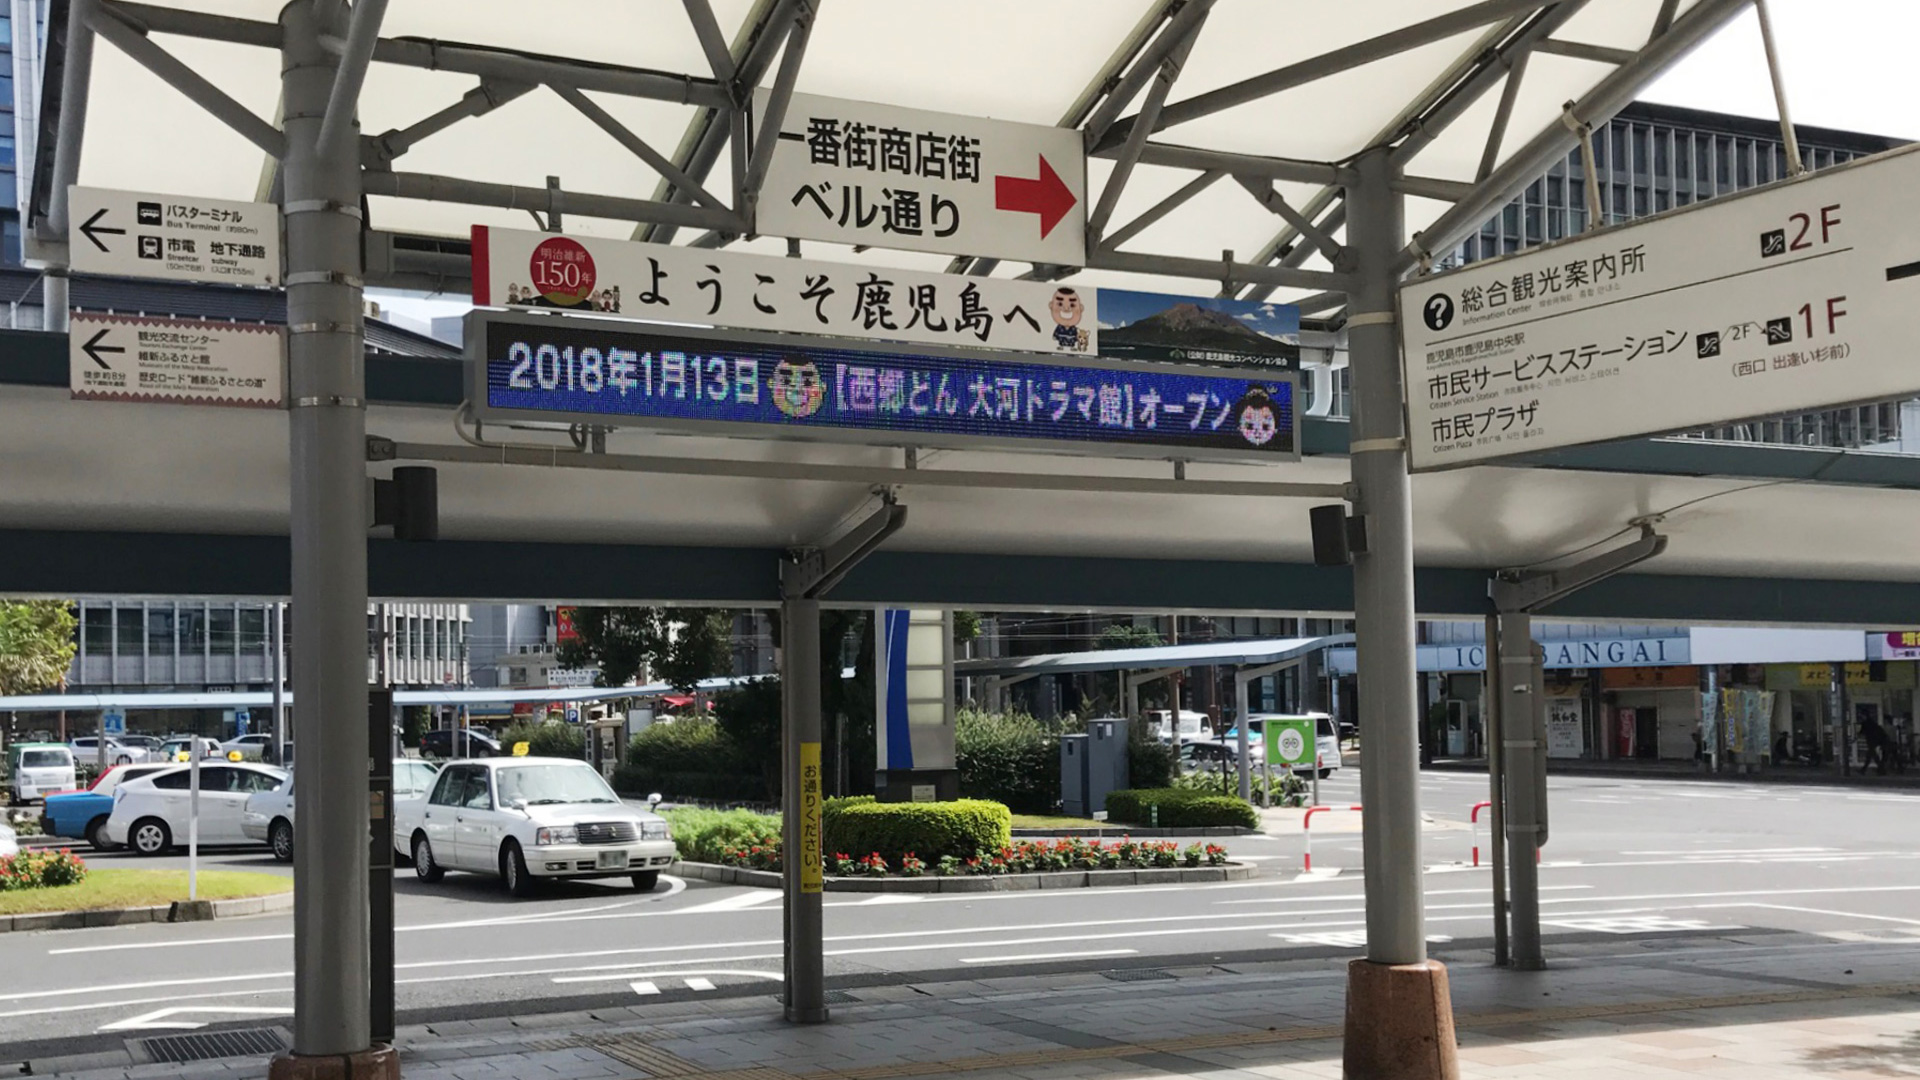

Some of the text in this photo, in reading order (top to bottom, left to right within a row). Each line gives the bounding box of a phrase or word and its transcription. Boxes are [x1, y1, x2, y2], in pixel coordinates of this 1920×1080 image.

[778, 117, 981, 184] 一番街商店街
[167, 205, 243, 223] バスターミナル
[791, 181, 960, 237] ベル通り
[167, 221, 183, 229] Bus
[186, 222, 221, 231] Terminal
[1789, 204, 1841, 251] 2F
[167, 238, 266, 259] 市電 地下通路
[540, 247, 586, 262] 明治維新
[167, 253, 238, 267] Streetcar subway
[1461, 244, 1646, 314] 総合観光案内所
[638, 257, 1041, 342] ようこそ鹿児島へ
[1462, 304, 1532, 326] Information Center
[1798, 296, 1847, 339] 1F
[138, 331, 219, 344] 観光交流センター
[1732, 325, 1750, 340] 2F
[138, 351, 211, 365] 維新ふるさと館
[1426, 332, 1525, 364] 鹿児島市鹿児島中央駅
[509, 342, 759, 405] 2018年1月13日
[1428, 329, 1688, 400] 市民サービスステーション
[1429, 390, 1499, 410] Citizen Service Station
[1432, 399, 1540, 442] 市民プラザ
[1433, 440, 1473, 453] Citizen Plaza
[569, 710, 577, 721] P
[804, 765, 817, 873] お通りください。
